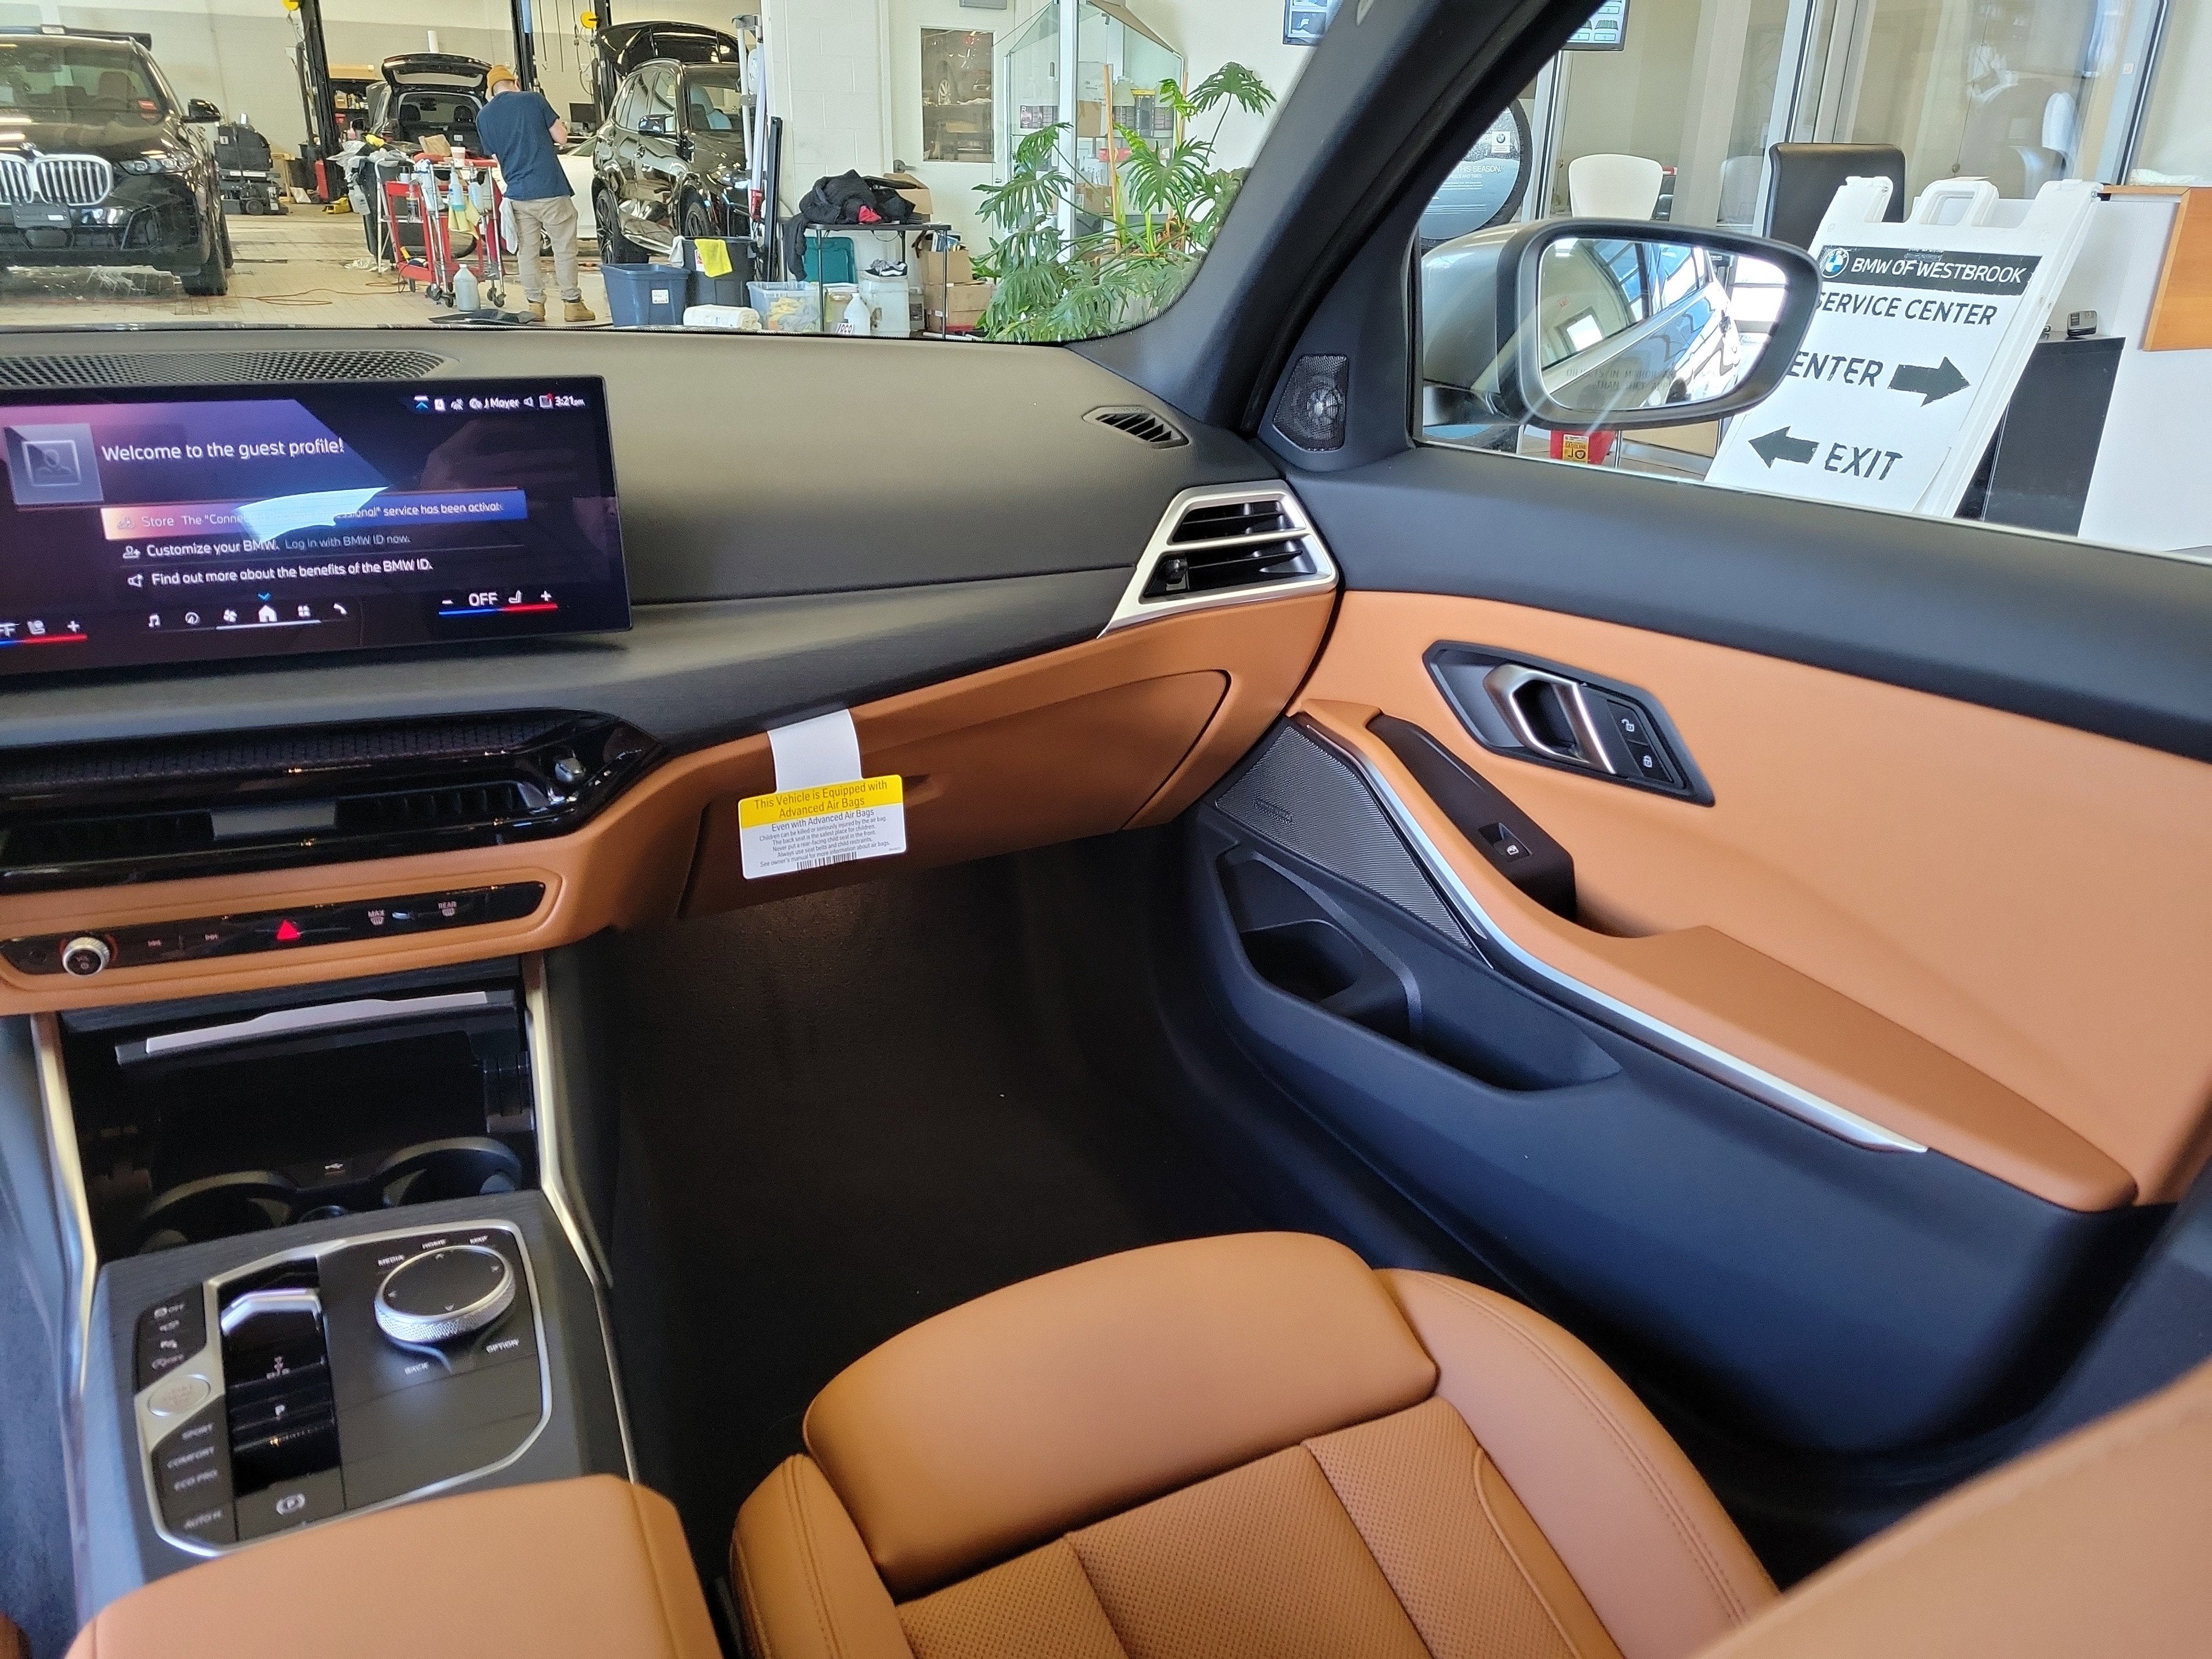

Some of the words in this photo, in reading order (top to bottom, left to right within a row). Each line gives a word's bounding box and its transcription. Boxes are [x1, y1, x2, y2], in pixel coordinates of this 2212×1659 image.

[1850, 257, 1893, 274] BMW
[1892, 259, 1917, 276] OF
[1916, 261, 2027, 284] WESTBROOK
[1904, 298, 1998, 326] CENTER
[1786, 351, 1883, 387] ENTER
[101, 445, 182, 461] Welcome
[185, 444, 204, 459] to
[207, 442, 235, 458] the
[239, 441, 285, 460] guest
[289, 437, 345, 458] profile!
[1824, 442, 1904, 481] EXIT
[142, 516, 174, 528] Store
[181, 515, 202, 526] The
[383, 504, 420, 516] service
[420, 504, 439, 515] has
[440, 503, 467, 514] been
[146, 542, 212, 557] Customize
[213, 542, 240, 556] your
[243, 539, 280, 552] BMW.
[285, 539, 305, 551] Log
[319, 536, 341, 548] with
[343, 534, 371, 546] BMW
[373, 534, 385, 545] ID
[386, 535, 411, 544] now.
[151, 572, 181, 585] Find
[183, 572, 204, 584] out
[205, 572, 238, 583] more
[240, 567, 276, 582] about
[277, 566, 298, 579] the
[299, 563, 346, 577] benefits
[348, 561, 360, 574] of
[362, 561, 382, 574] the
[383, 558, 415, 572] BMW
[416, 558, 433, 571] ID.
[469, 592, 498, 606] OFF
[755, 798, 774, 809] This
[776, 792, 810, 805] Vehicle
[812, 791, 820, 800] is
[822, 782, 866, 798] Equipped
[868, 780, 888, 791] with
[779, 802, 825, 819] Advanced
[827, 799, 839, 810] Air
[842, 798, 865, 809] Bags
[771, 823, 790, 832] Even
[791, 819, 806, 828] with
[808, 812, 843, 826] Advanced
[844, 810, 855, 820] Air
[856, 809, 874, 818] Bags
[368, 910, 385, 918] MAX
[377, 1254, 405, 1267] MEDIA
[486, 1339, 520, 1353] OPTION
